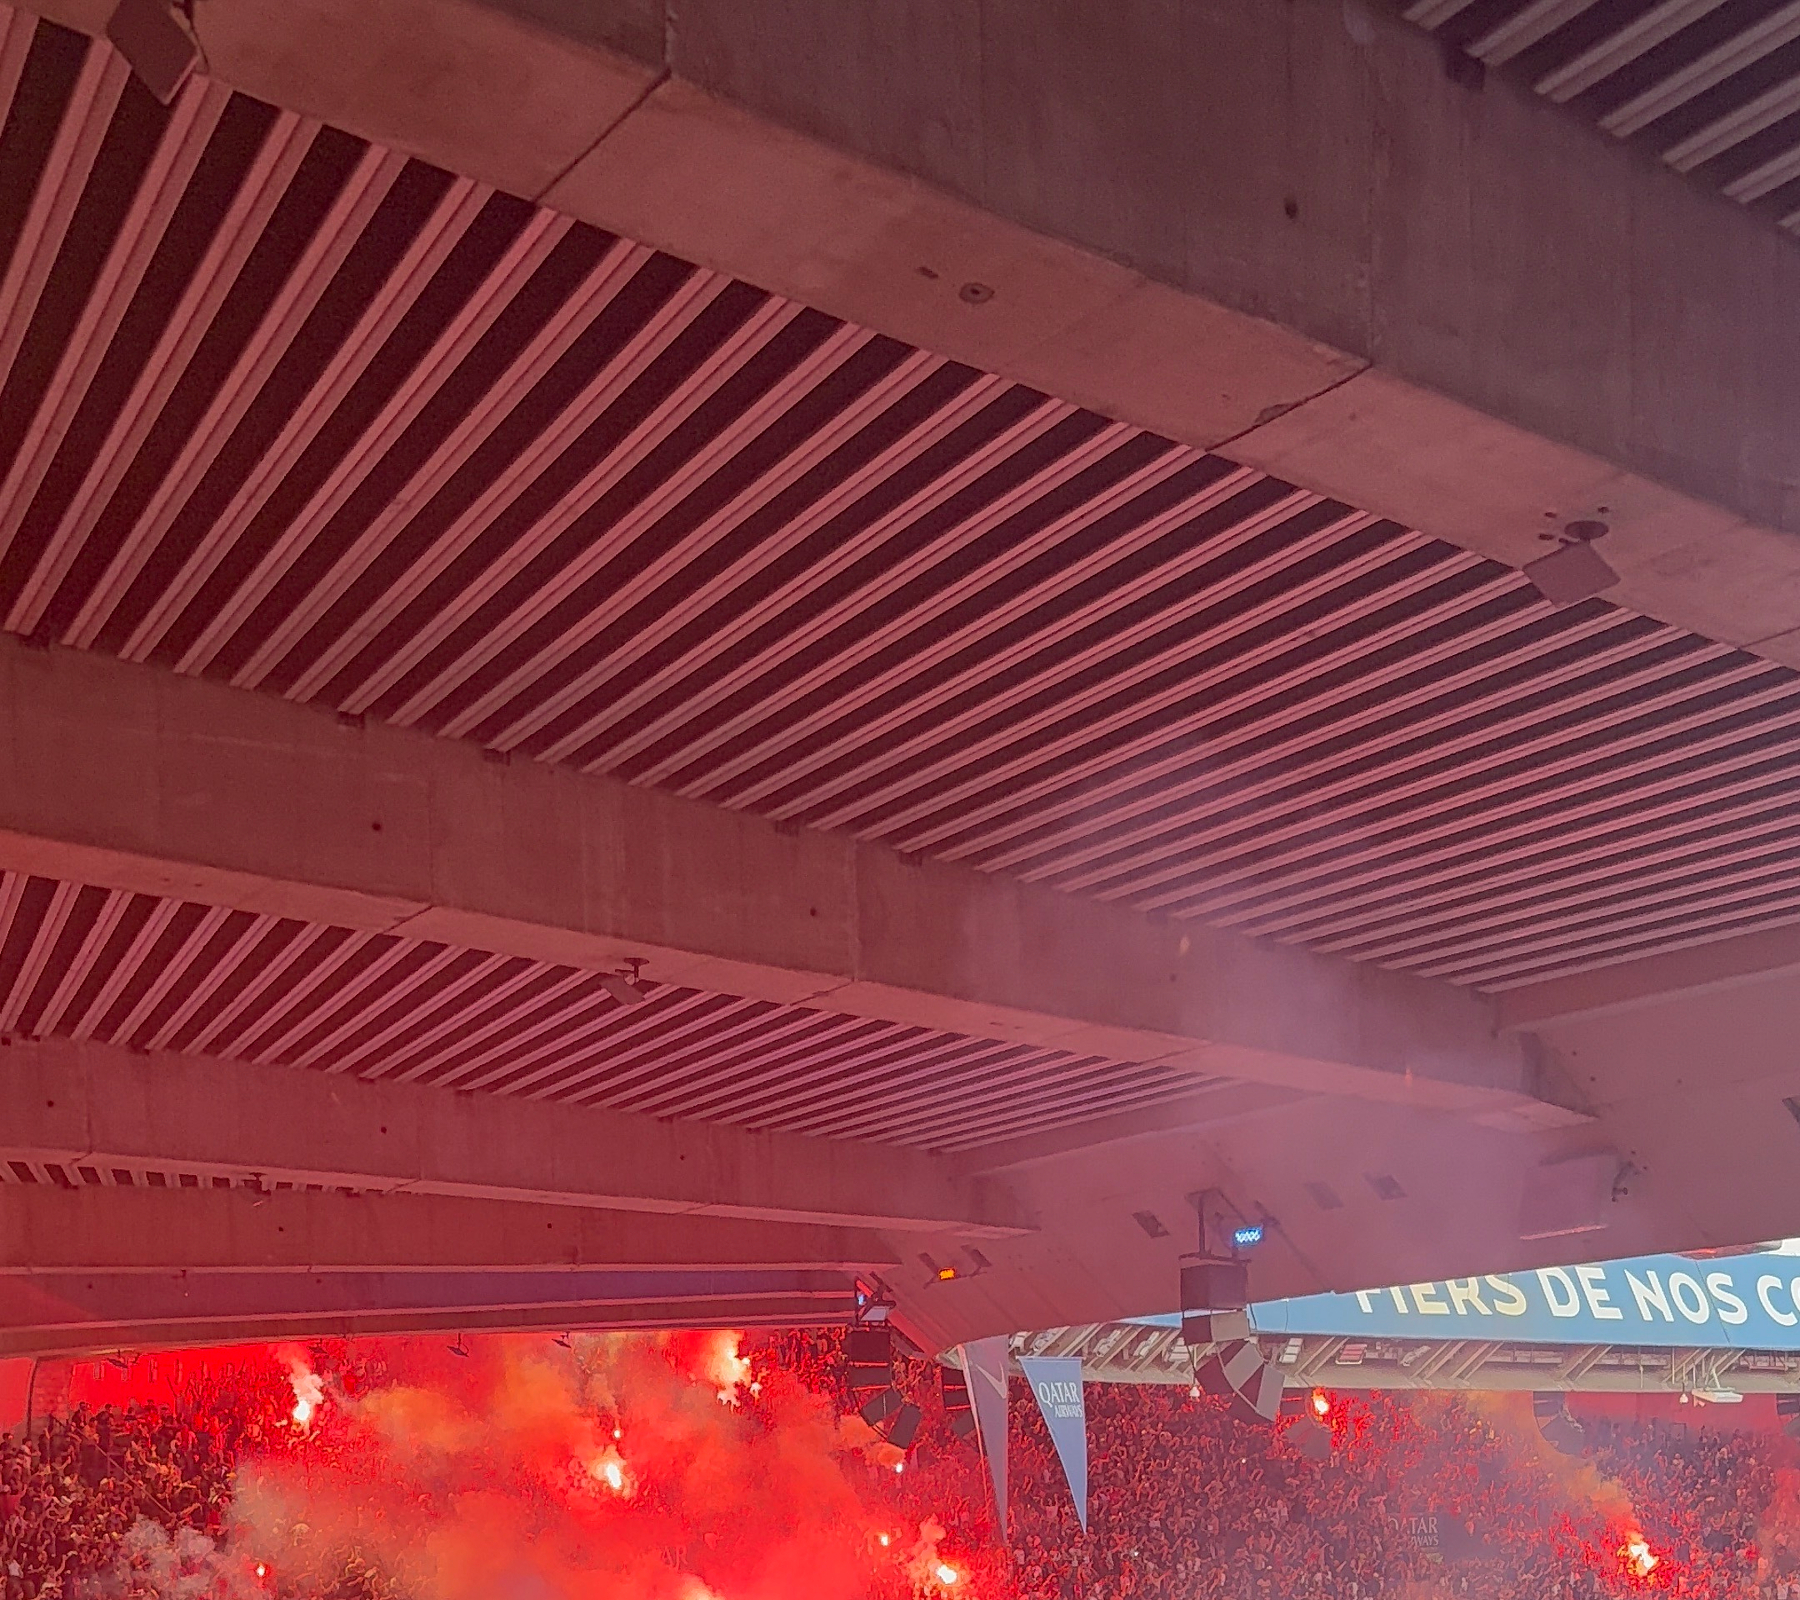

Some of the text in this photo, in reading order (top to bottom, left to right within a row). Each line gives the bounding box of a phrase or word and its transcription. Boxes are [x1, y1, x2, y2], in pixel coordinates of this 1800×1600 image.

[1355, 1273, 1528, 1317] FIERS
[1535, 1266, 1625, 1321] DE
[1624, 1267, 1750, 1325] NOS
[1039, 1381, 1081, 1408] QATAR
[1387, 1515, 1439, 1535] TAR
